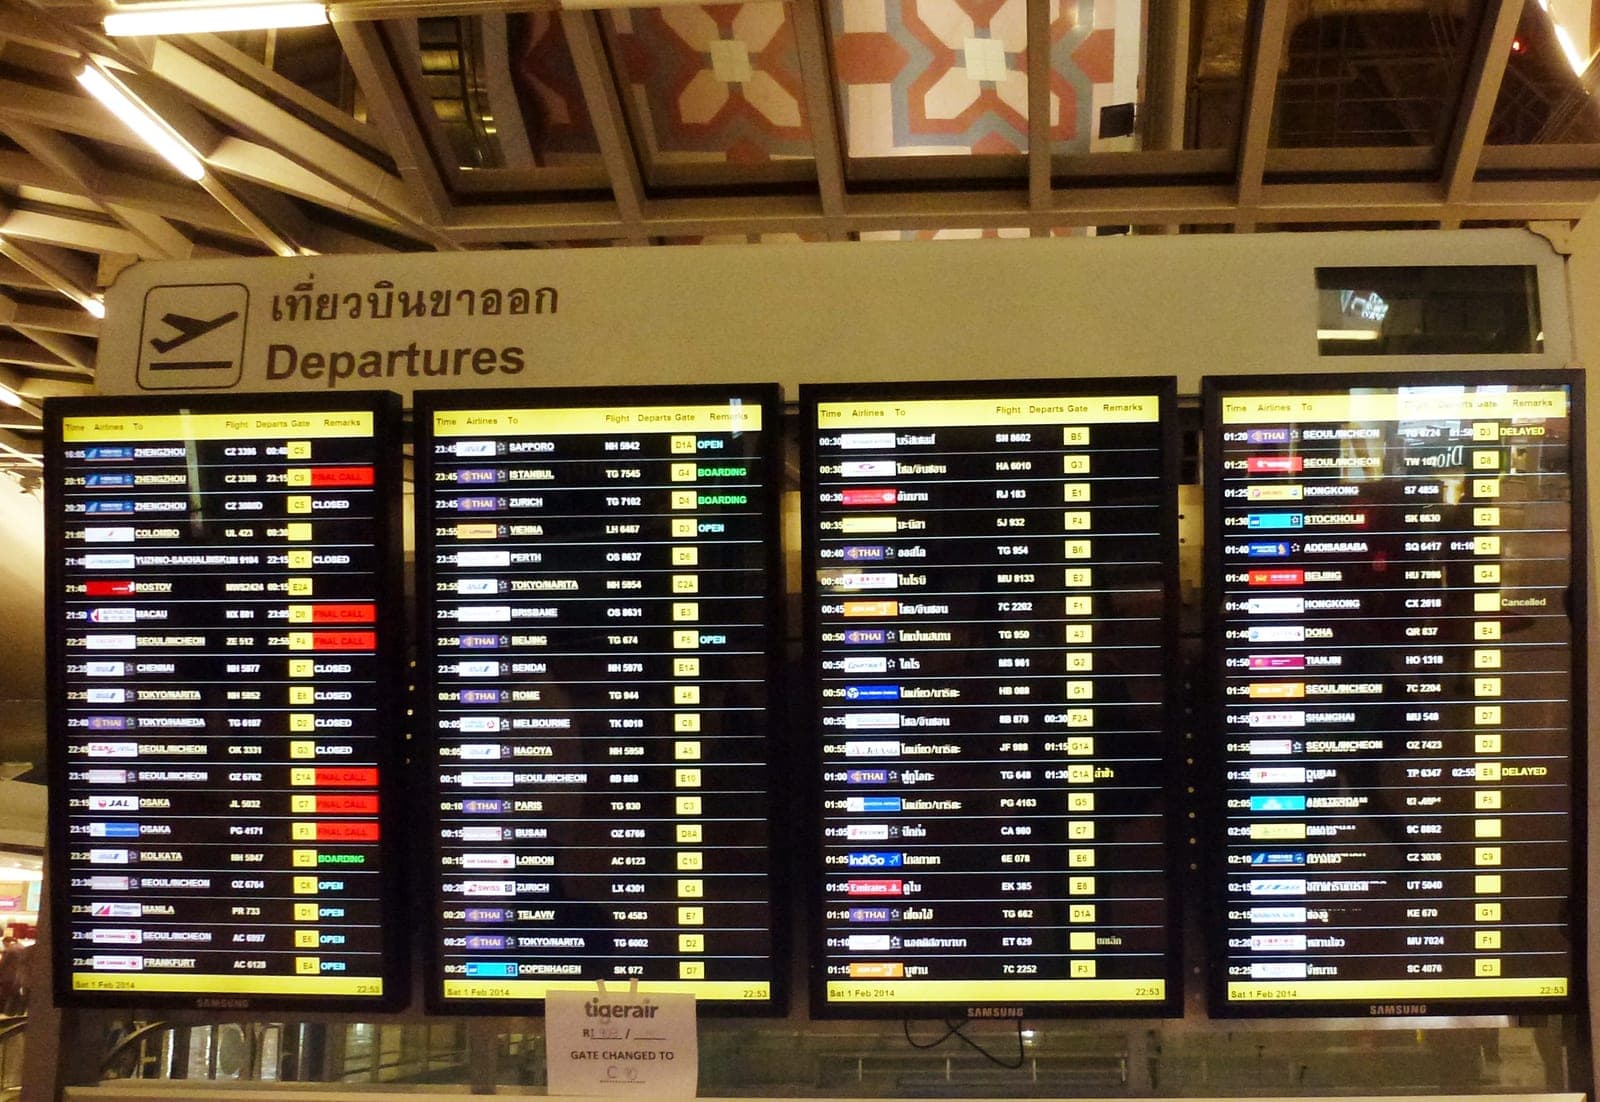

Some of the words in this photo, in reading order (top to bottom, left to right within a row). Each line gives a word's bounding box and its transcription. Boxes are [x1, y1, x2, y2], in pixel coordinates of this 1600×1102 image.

[272, 273, 558, 321] เที่ยวบินขาออก
[266, 342, 525, 387] Departures
[1226, 404, 1247, 412] Time
[1257, 404, 1291, 412] Airlines
[1513, 399, 1552, 407] Remarks
[852, 409, 884, 417] Airlines
[996, 406, 1020, 415] Flight
[1029, 406, 1063, 414] Departs
[1103, 404, 1143, 412] Remarks
[466, 417, 497, 425] Airlines
[606, 415, 629, 423] Flight
[638, 414, 671, 422] Departs
[225, 421, 248, 429] Flight
[256, 421, 287, 429] Departs
[1224, 432, 1248, 440] 01:20
[1263, 432, 1284, 440] THAI
[1500, 427, 1545, 435] DELAYED
[509, 443, 554, 451] SAPPORO
[697, 440, 723, 448] OPEN
[471, 472, 492, 480] THAI
[509, 470, 554, 479] ISTANBUL
[698, 468, 746, 476] BOARDING
[1304, 486, 1358, 495] HONGKONG
[313, 501, 349, 509] CLOSED
[509, 498, 543, 506] ZURICH
[698, 496, 747, 504] BOARDING
[1304, 514, 1365, 524] STOCKHOLM
[698, 524, 724, 532] OPEN
[1226, 545, 1249, 553] 01:40
[313, 556, 349, 564] CLOSED
[511, 553, 541, 562] PERTH
[1226, 574, 1249, 582] 01:40
[136, 583, 172, 591] ROSTOV
[1305, 599, 1359, 608] HONGKONG
[1501, 598, 1546, 606] Cancelled
[700, 636, 725, 644] OPEN
[823, 633, 845, 641] 00:50
[314, 664, 351, 673] CLOSED
[315, 692, 351, 700] CLOSED
[513, 692, 540, 700] ROME
[823, 689, 846, 697] 00:50
[1306, 713, 1355, 722] SHANGHAI
[315, 719, 352, 727] CLOSED
[316, 746, 352, 754] CLOSED
[824, 745, 846, 753] 00:55
[1502, 767, 1546, 776] DELAYED
[824, 773, 847, 781] 01:00
[515, 802, 542, 811] PARIS
[140, 826, 171, 834] OSAKA
[515, 829, 547, 838] BUSAN
[825, 828, 847, 836] 01:05
[318, 855, 364, 863] BOARDING
[516, 856, 554, 865] LONDON
[826, 856, 848, 864] 01:05
[850, 854, 884, 865] IndiGo
[319, 882, 343, 890] OPEN
[517, 884, 549, 893] ZURICH
[851, 884, 887, 892] Emirates
[319, 909, 344, 917] OPEN
[518, 911, 555, 920] TELAVIV
[827, 911, 849, 919] 01:10
[321, 962, 345, 970] OPEN
[519, 965, 581, 974] COPENHAGEN
[1003, 965, 1015, 973] 7C
[1017, 965, 1037, 973] 2252
[1540, 986, 1564, 994] 22:53
[584, 997, 658, 1024] tigerair
[967, 1008, 1023, 1017] SAMSUNG
[1370, 1005, 1426, 1015] SAMSUNG
[571, 1051, 599, 1060] GATE
[602, 1051, 656, 1060] CHANGED
[660, 1052, 674, 1060] TO
